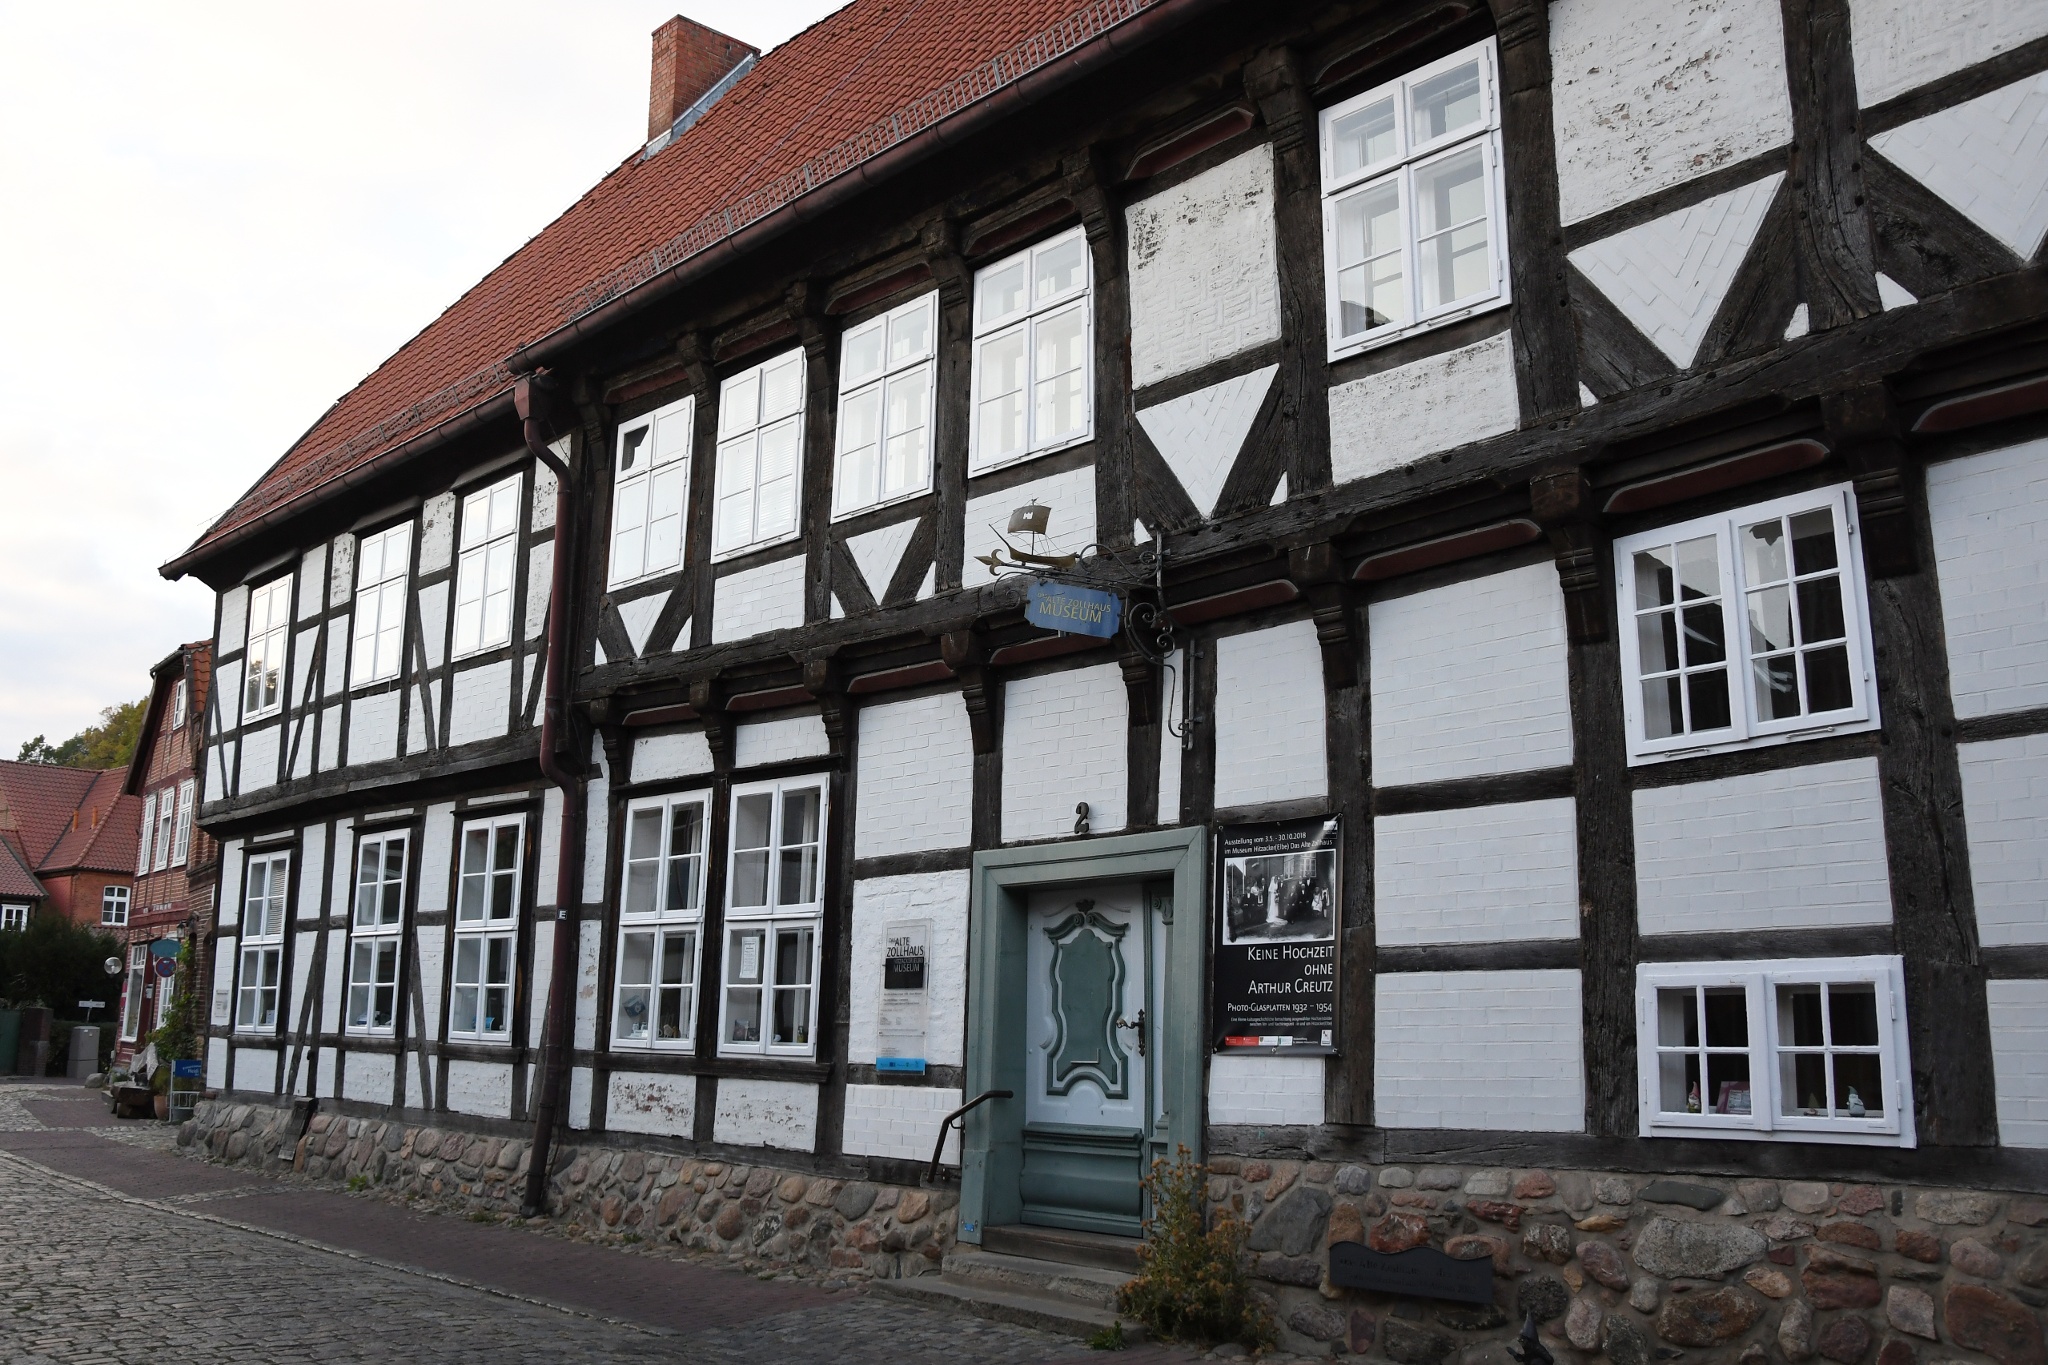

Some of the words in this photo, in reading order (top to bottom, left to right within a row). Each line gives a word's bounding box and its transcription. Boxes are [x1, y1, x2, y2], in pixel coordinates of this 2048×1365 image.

[1046, 596, 1066, 605] ALTE
[1068, 599, 1111, 613] ZOLLHAUS
[1039, 602, 1102, 623] MUSEUM
[1074, 801, 1090, 834] 2
[1224, 836, 1252, 847] Ausstellung
[1278, 832, 1307, 842] 30.10.2018
[1231, 846, 1252, 855] Museum
[1290, 842, 1300, 850] Das
[1300, 841, 1311, 849] Alte
[895, 936, 910, 947] ALTE
[886, 945, 924, 958] ZOLLHAUS
[1248, 946, 1279, 961] KEINE
[1283, 945, 1335, 960] HOCHZEIT
[893, 963, 920, 973] MUSEUM
[1304, 963, 1333, 976] OHNE
[1247, 980, 1291, 994] ARTHUR
[1294, 978, 1333, 994] CREUTZ
[1227, 1002, 1290, 1012] PHOTO-GLASPLATTEN
[1292, 1003, 1308, 1013] 1932
[1316, 1003, 1332, 1013] 1954
